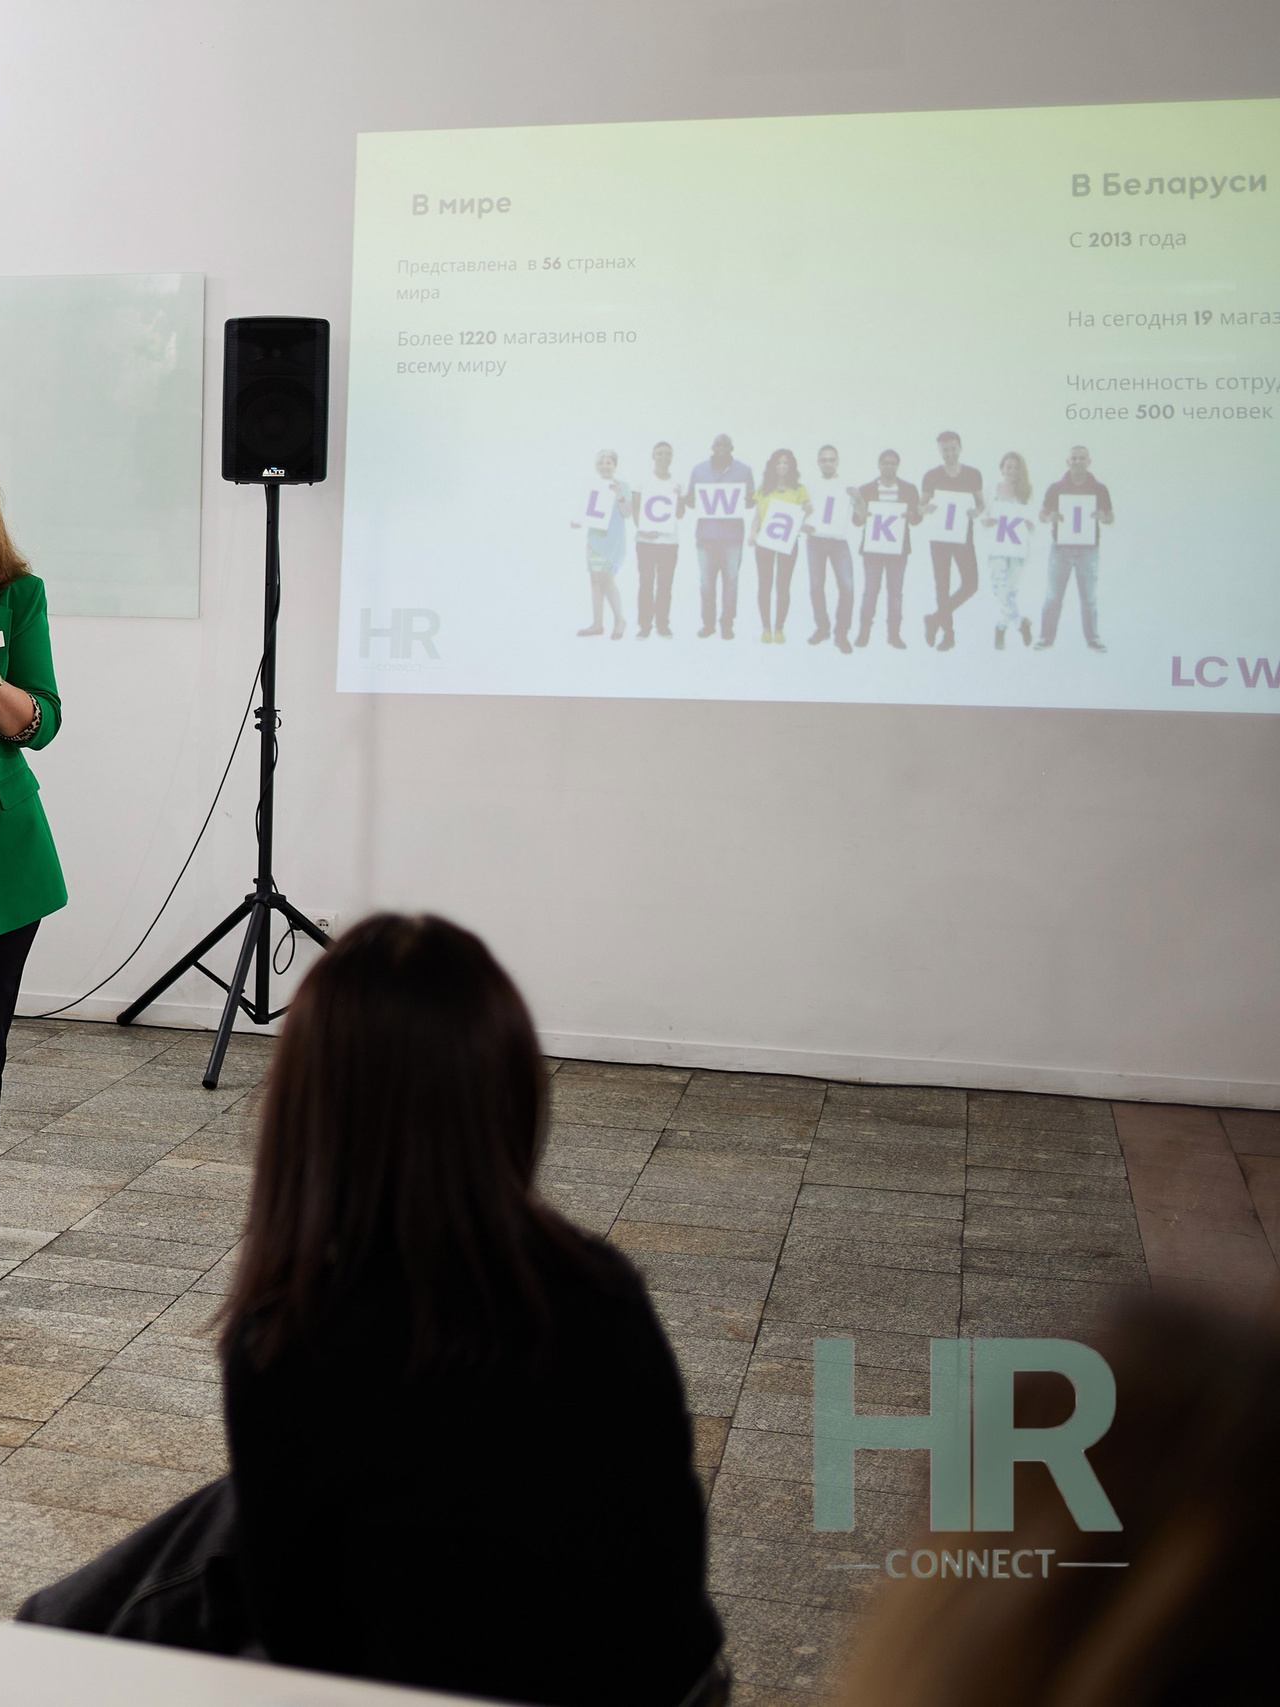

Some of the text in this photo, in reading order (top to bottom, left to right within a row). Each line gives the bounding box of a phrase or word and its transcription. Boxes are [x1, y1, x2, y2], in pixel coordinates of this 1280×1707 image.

[1071, 172, 1267, 199] В Беларуси
[412, 194, 511, 219] В мире
[1069, 231, 1186, 249] С 2013 года
[397, 256, 636, 277] Представлена в 56 странах
[396, 288, 440, 303] мира
[1067, 311, 1095, 327] На
[1102, 311, 1187, 329] сегодня
[1193, 310, 1213, 325] 19
[398, 331, 637, 346] Более 1220 магазинов по
[396, 359, 507, 377] всему миру
[1066, 375, 1207, 391] Численность
[1065, 403, 1273, 420] более 500 человек
[262, 467, 285, 476] ALTO
[358, 608, 442, 660] HR
